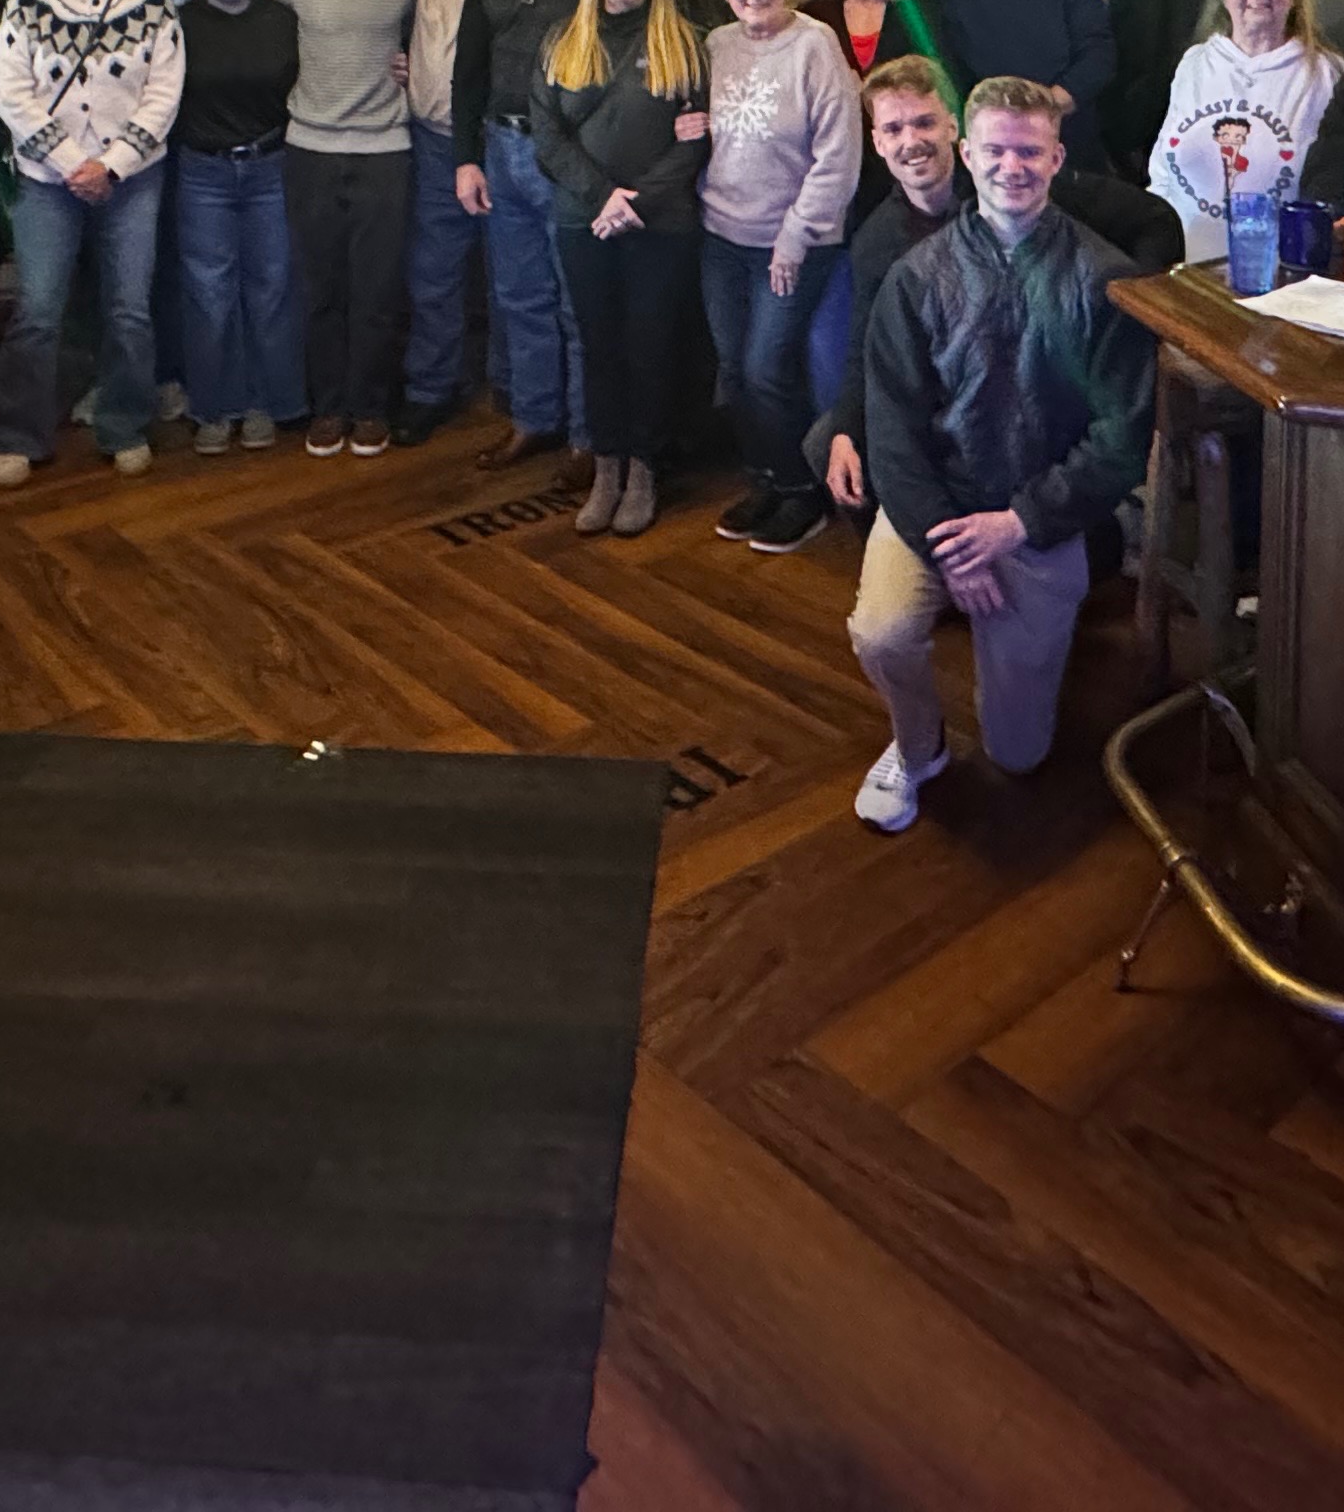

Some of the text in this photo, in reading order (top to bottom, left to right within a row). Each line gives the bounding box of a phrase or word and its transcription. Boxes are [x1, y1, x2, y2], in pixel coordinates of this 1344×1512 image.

[1178, 98, 1293, 143] CLASSY & SASSY
[430, 491, 583, 546] IRON
